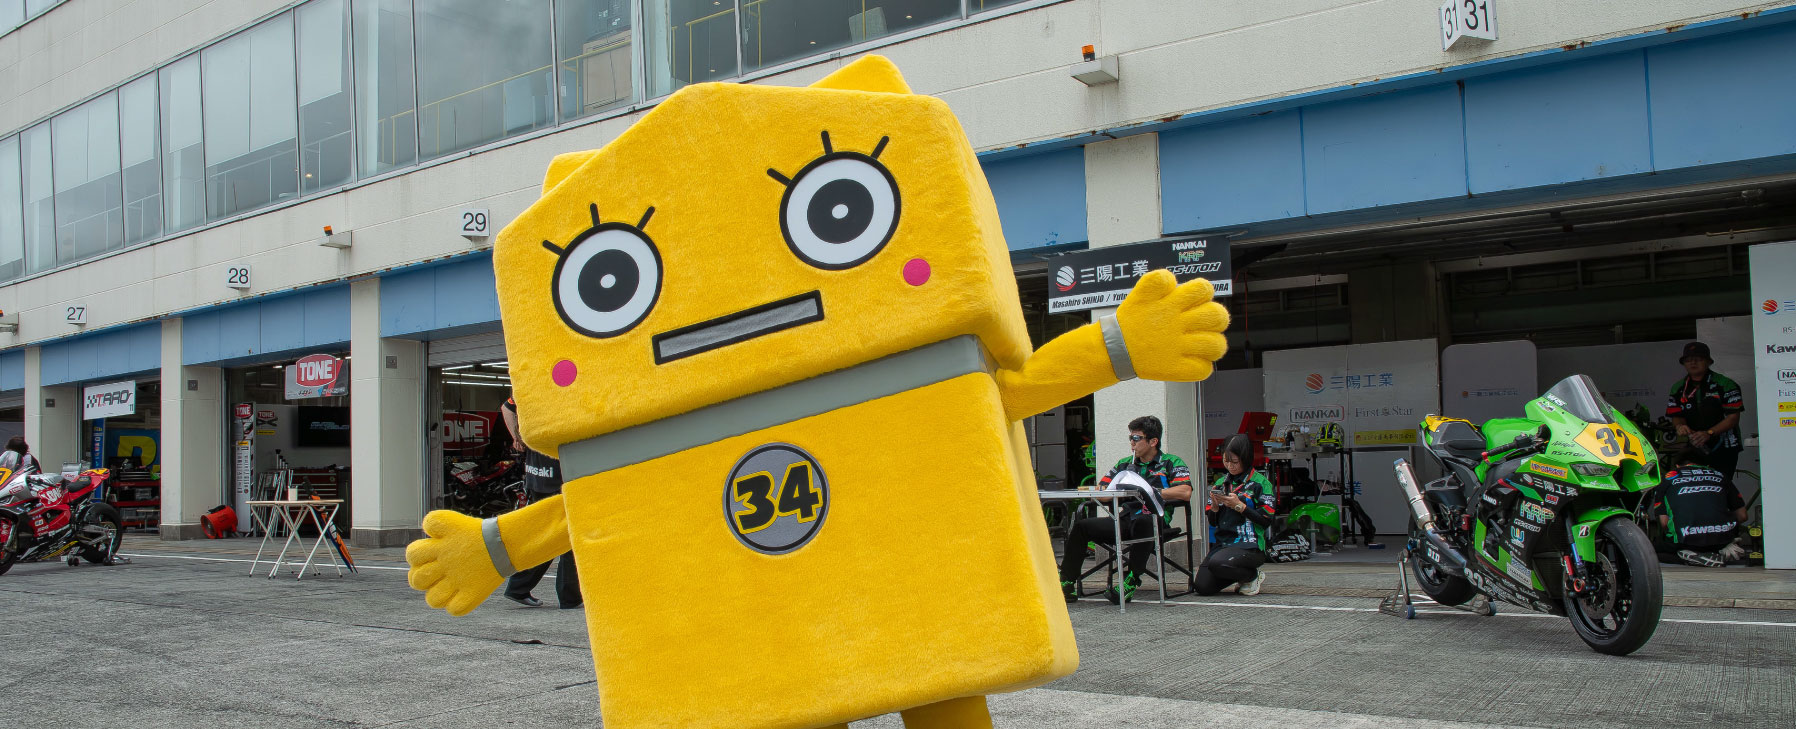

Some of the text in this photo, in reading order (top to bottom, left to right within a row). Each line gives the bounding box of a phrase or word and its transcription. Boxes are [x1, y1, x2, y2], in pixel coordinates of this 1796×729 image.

[1445, 0, 1458, 40] 31
[1464, 0, 1489, 32] 31
[463, 212, 487, 232] 29
[1172, 240, 1207, 251] NANKAI
[1178, 250, 1205, 263] KRP
[228, 267, 249, 285] 28
[1080, 259, 1149, 285] 三陽工業
[1052, 299, 1080, 309] Masahiro
[1082, 295, 1105, 305] SHINJO
[66, 306, 86, 321] 27
[300, 359, 333, 382] TONE
[1330, 373, 1394, 390] 三陽工業
[236, 406, 251, 417] TONE
[1294, 409, 1340, 420] NANKAI
[1355, 405, 1413, 418] First Star
[443, 420, 484, 443] ONE
[1596, 427, 1638, 458] 32
[733, 461, 823, 535] 34
[1520, 500, 1556, 525] KRP
